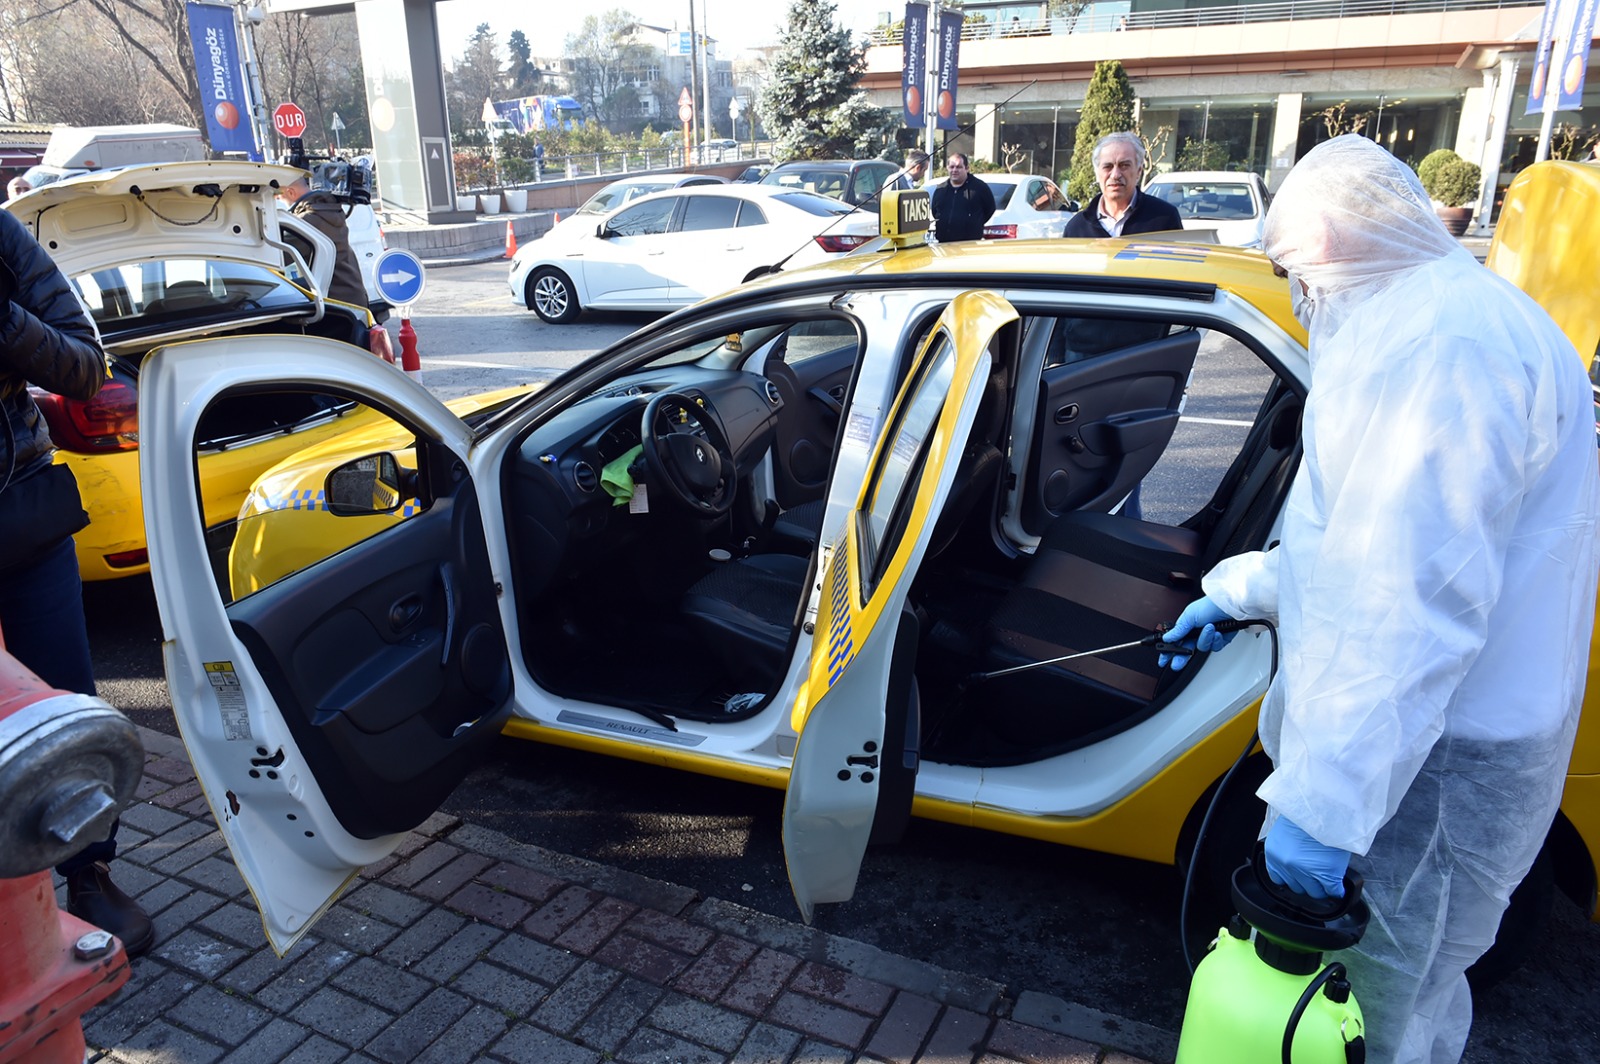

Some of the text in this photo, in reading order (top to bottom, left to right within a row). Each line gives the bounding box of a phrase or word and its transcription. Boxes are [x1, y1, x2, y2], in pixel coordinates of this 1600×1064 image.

[205, 27, 227, 100] Dünyagöz
[908, 17, 918, 85] Dünyagöz
[941, 25, 953, 90] Dünyagöz
[276, 113, 304, 129] DUR
[606, 722, 649, 735] RENAULT
